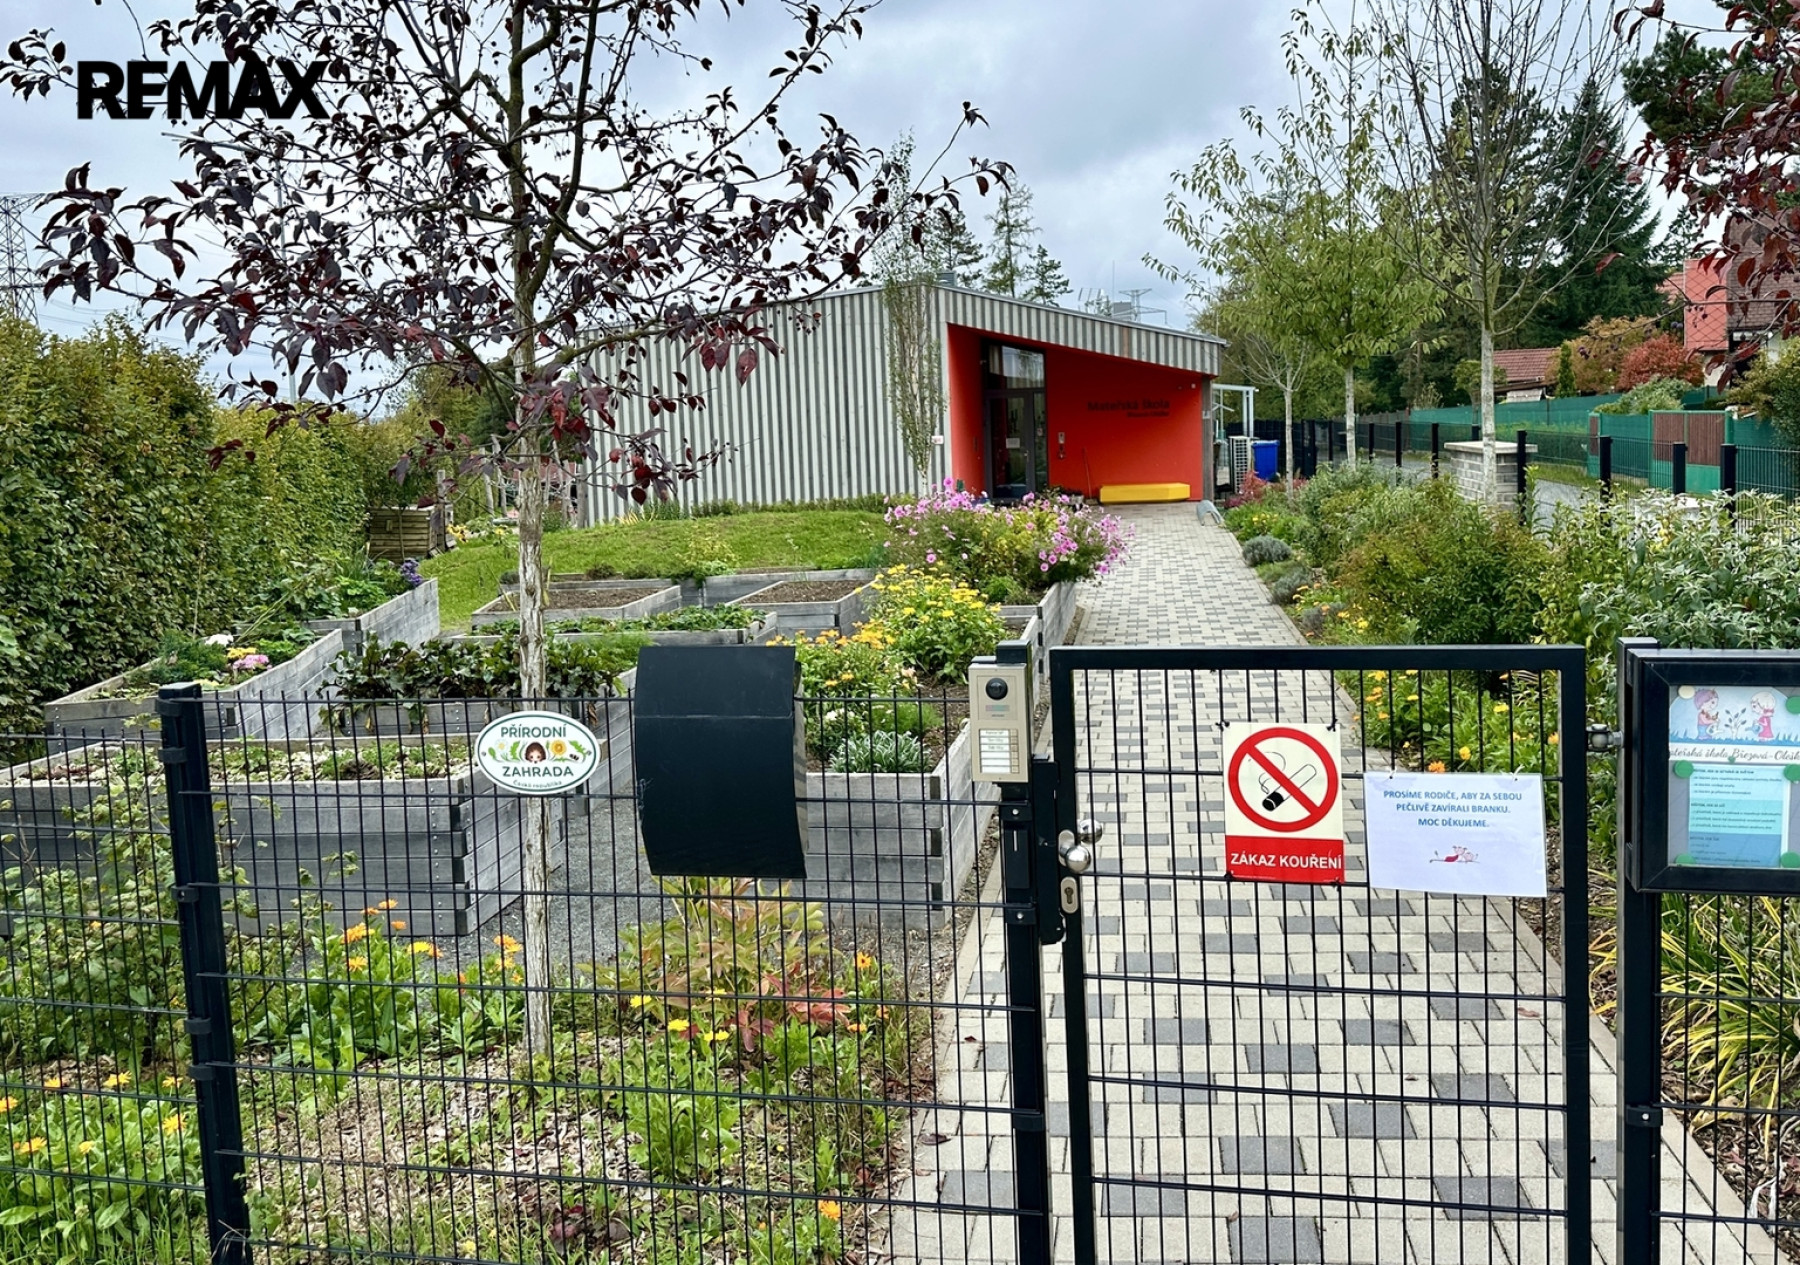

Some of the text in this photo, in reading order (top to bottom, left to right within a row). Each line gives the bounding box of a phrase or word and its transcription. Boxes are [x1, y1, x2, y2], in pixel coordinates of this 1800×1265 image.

[501, 724, 567, 738] PŘÍRODNÍ
[1669, 747, 1703, 758] ateřská
[502, 766, 574, 777] ZAHRADA
[1383, 789, 1522, 801] PROSÍME RODIČE, ABY ZA SEBOU
[1396, 802, 1511, 814] PEČLIVĚ ZAVÍRALI BRANKU.
[1418, 818, 1490, 828] MOC DĚKUJEME.
[1230, 851, 1342, 869] ZÁKAZ KOUŘENÍ
